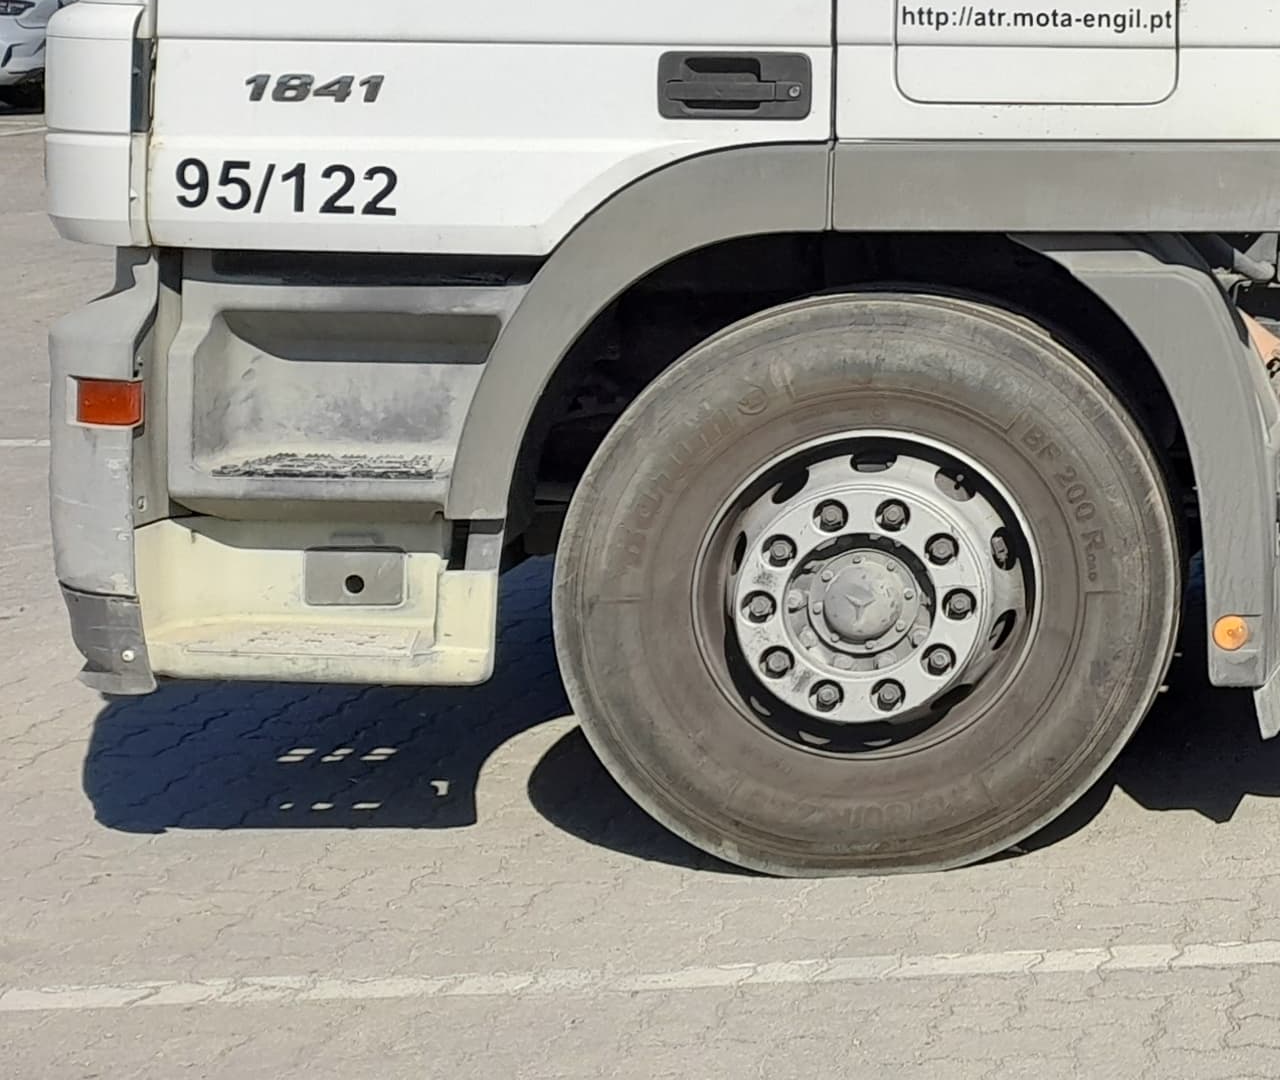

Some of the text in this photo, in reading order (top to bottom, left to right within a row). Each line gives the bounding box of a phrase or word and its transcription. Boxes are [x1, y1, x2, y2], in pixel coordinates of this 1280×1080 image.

[901, 6, 1173, 34] http://atr.mota-engil.pt
[244, 73, 386, 103] 1841
[174, 157, 400, 217] 95/122
